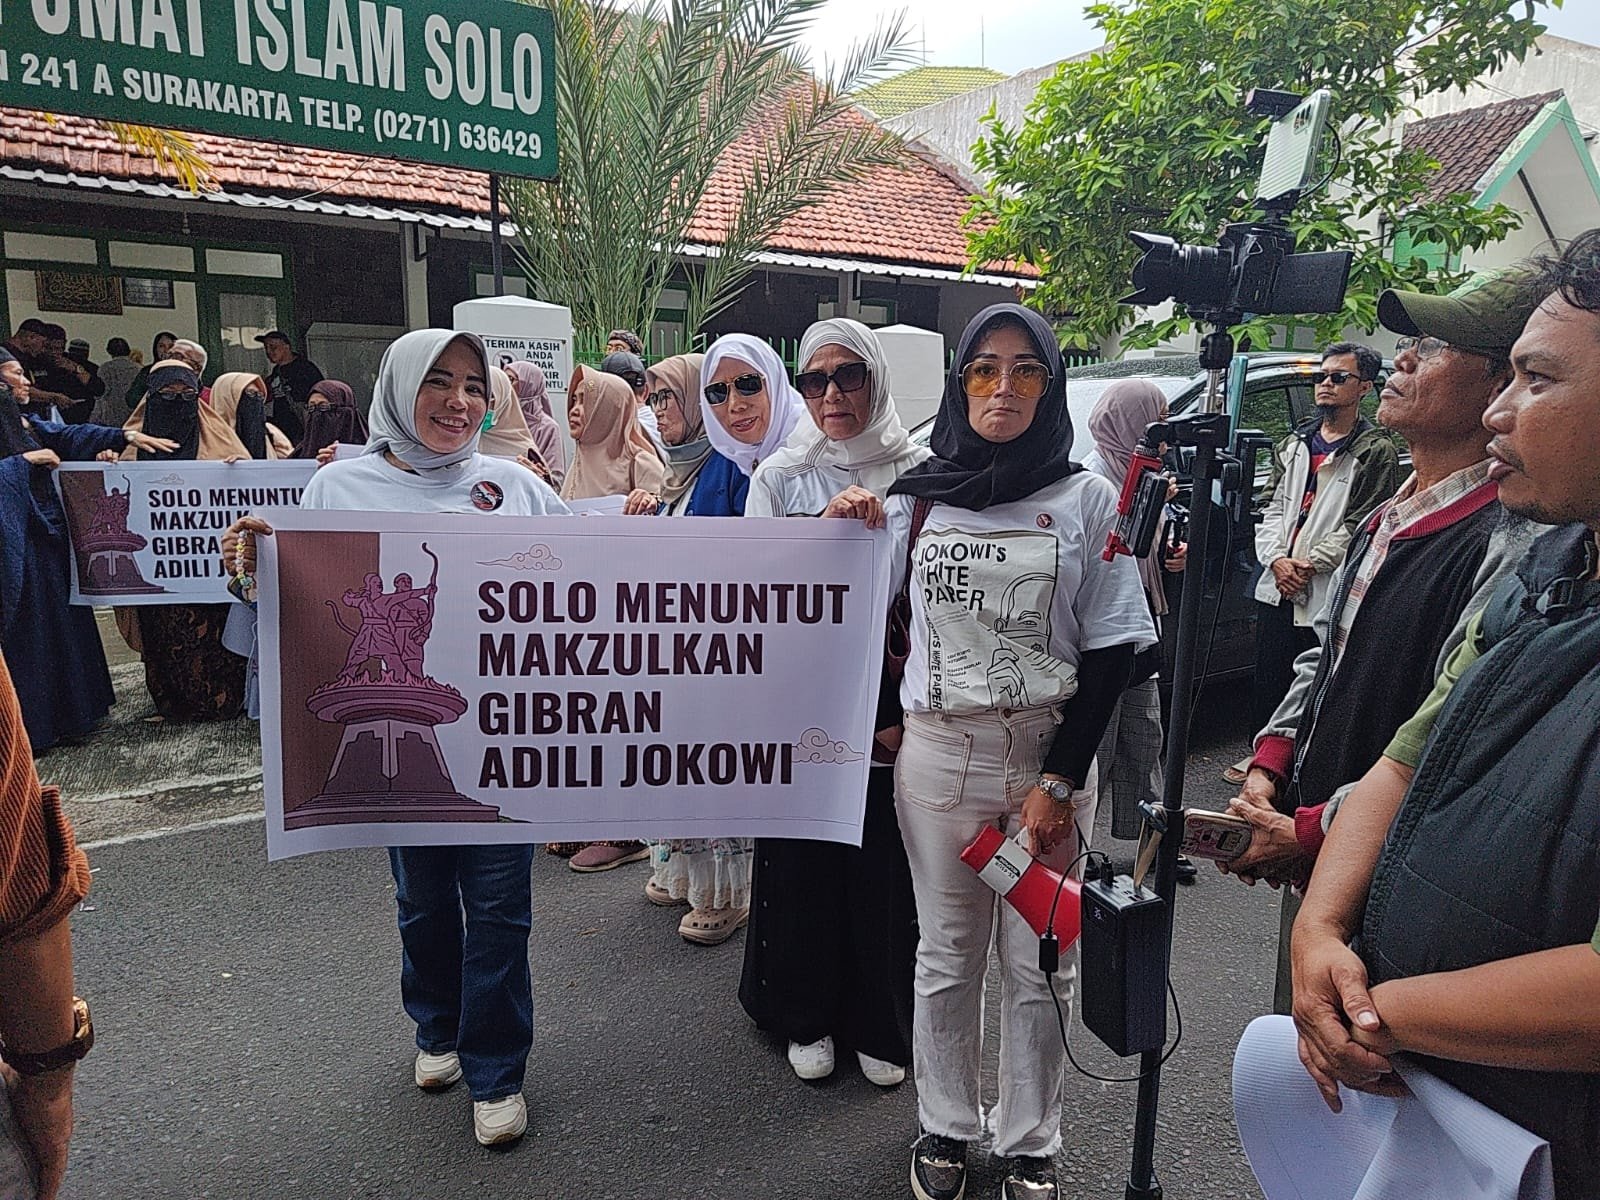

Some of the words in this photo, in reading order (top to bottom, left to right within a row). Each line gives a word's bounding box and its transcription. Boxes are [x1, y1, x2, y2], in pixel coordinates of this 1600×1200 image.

[234, 0, 405, 91] ISLAM
[425, 13, 541, 115] SOLO
[20, 53, 78, 91] 241
[93, 63, 114, 96] A
[123, 68, 292, 124] SURAKARTA
[299, 96, 364, 134] TELP.
[374, 108, 450, 151] (0271)
[458, 121, 541, 160] 636429
[485, 339, 525, 350] TERIMA
[528, 341, 560, 351] KASIH
[526, 351, 553, 360] ANDA
[148, 489, 201, 508] SOLO
[209, 488, 303, 507] MENUNTU
[152, 535, 222, 556] GIBRA
[154, 559, 209, 578] ADILI
[477, 580, 597, 624] SOLO
[616, 582, 850, 624] MENUNTUT
[478, 633, 763, 677] MAKZULKAN
[931, 673, 942, 710] PAPER
[478, 691, 661, 735] GIBRAN
[478, 745, 601, 789] ADILI
[620, 743, 793, 788] JOKOWI
